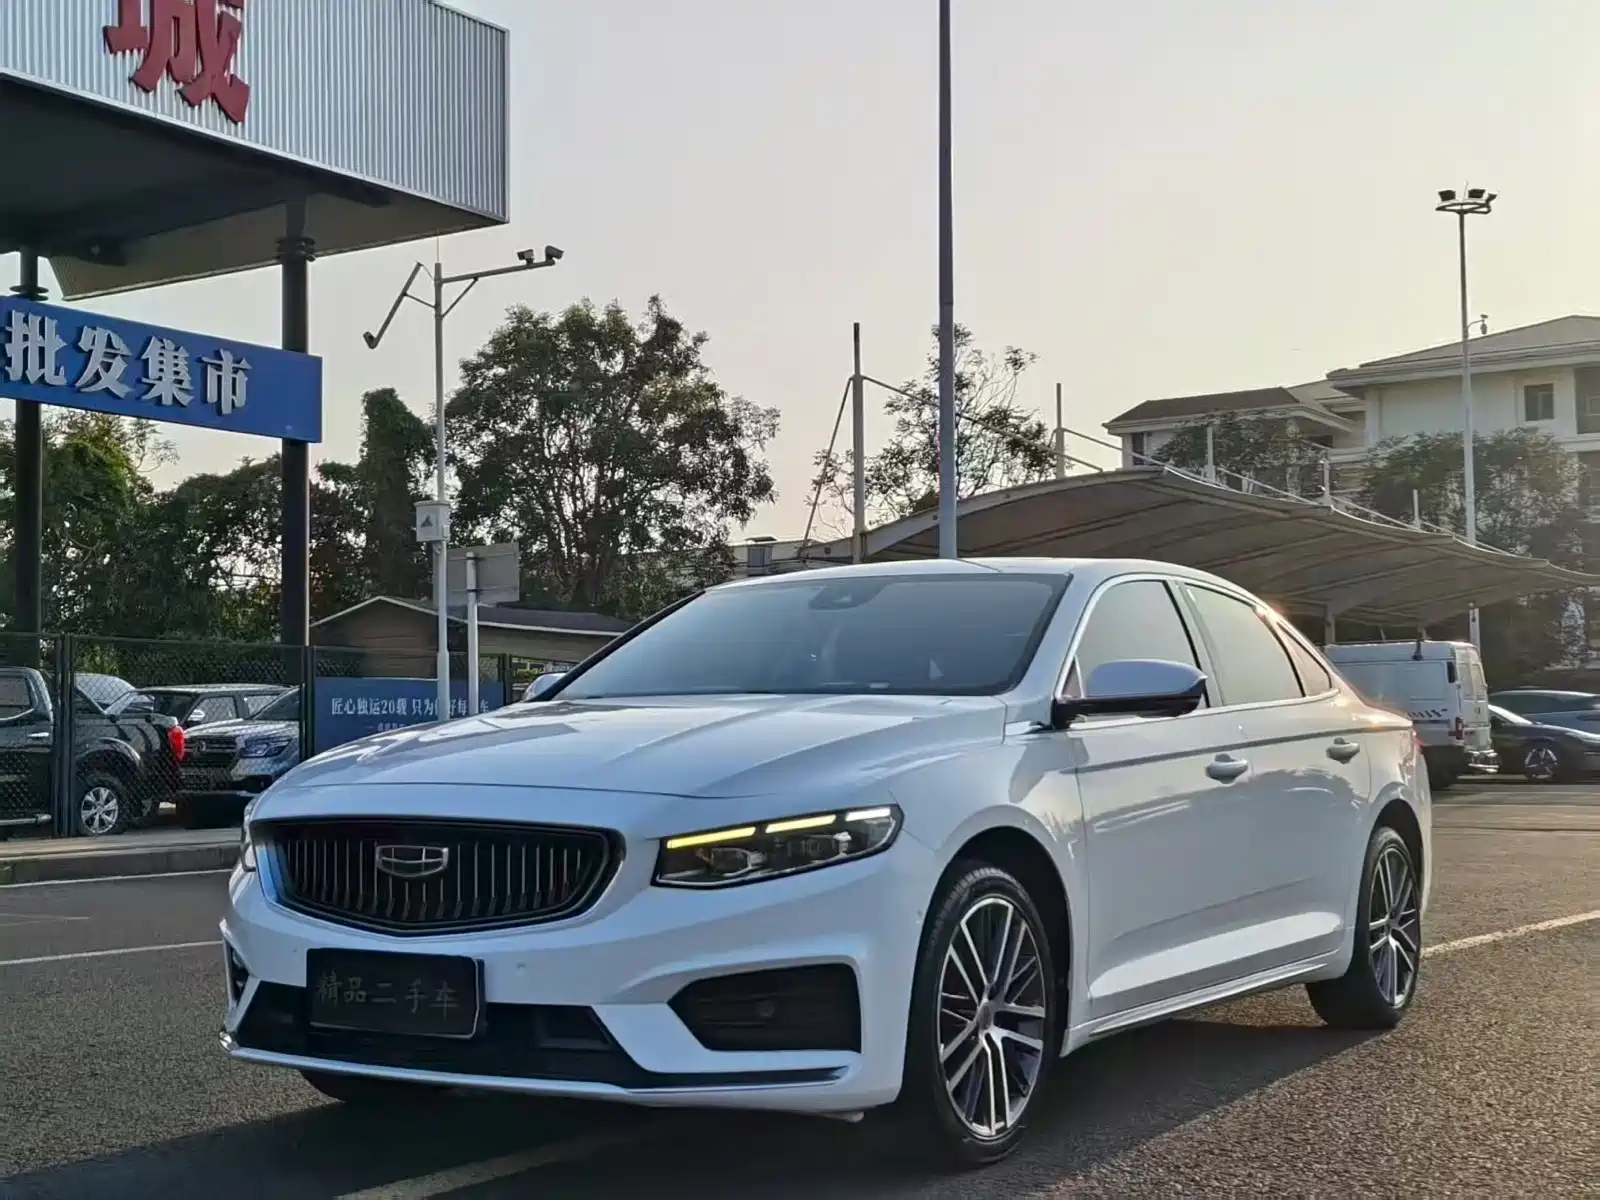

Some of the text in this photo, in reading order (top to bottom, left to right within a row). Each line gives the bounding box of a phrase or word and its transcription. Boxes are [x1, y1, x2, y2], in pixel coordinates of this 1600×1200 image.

[4, 309, 253, 415] 批发集市
[316, 968, 460, 1021] 精品二手车
